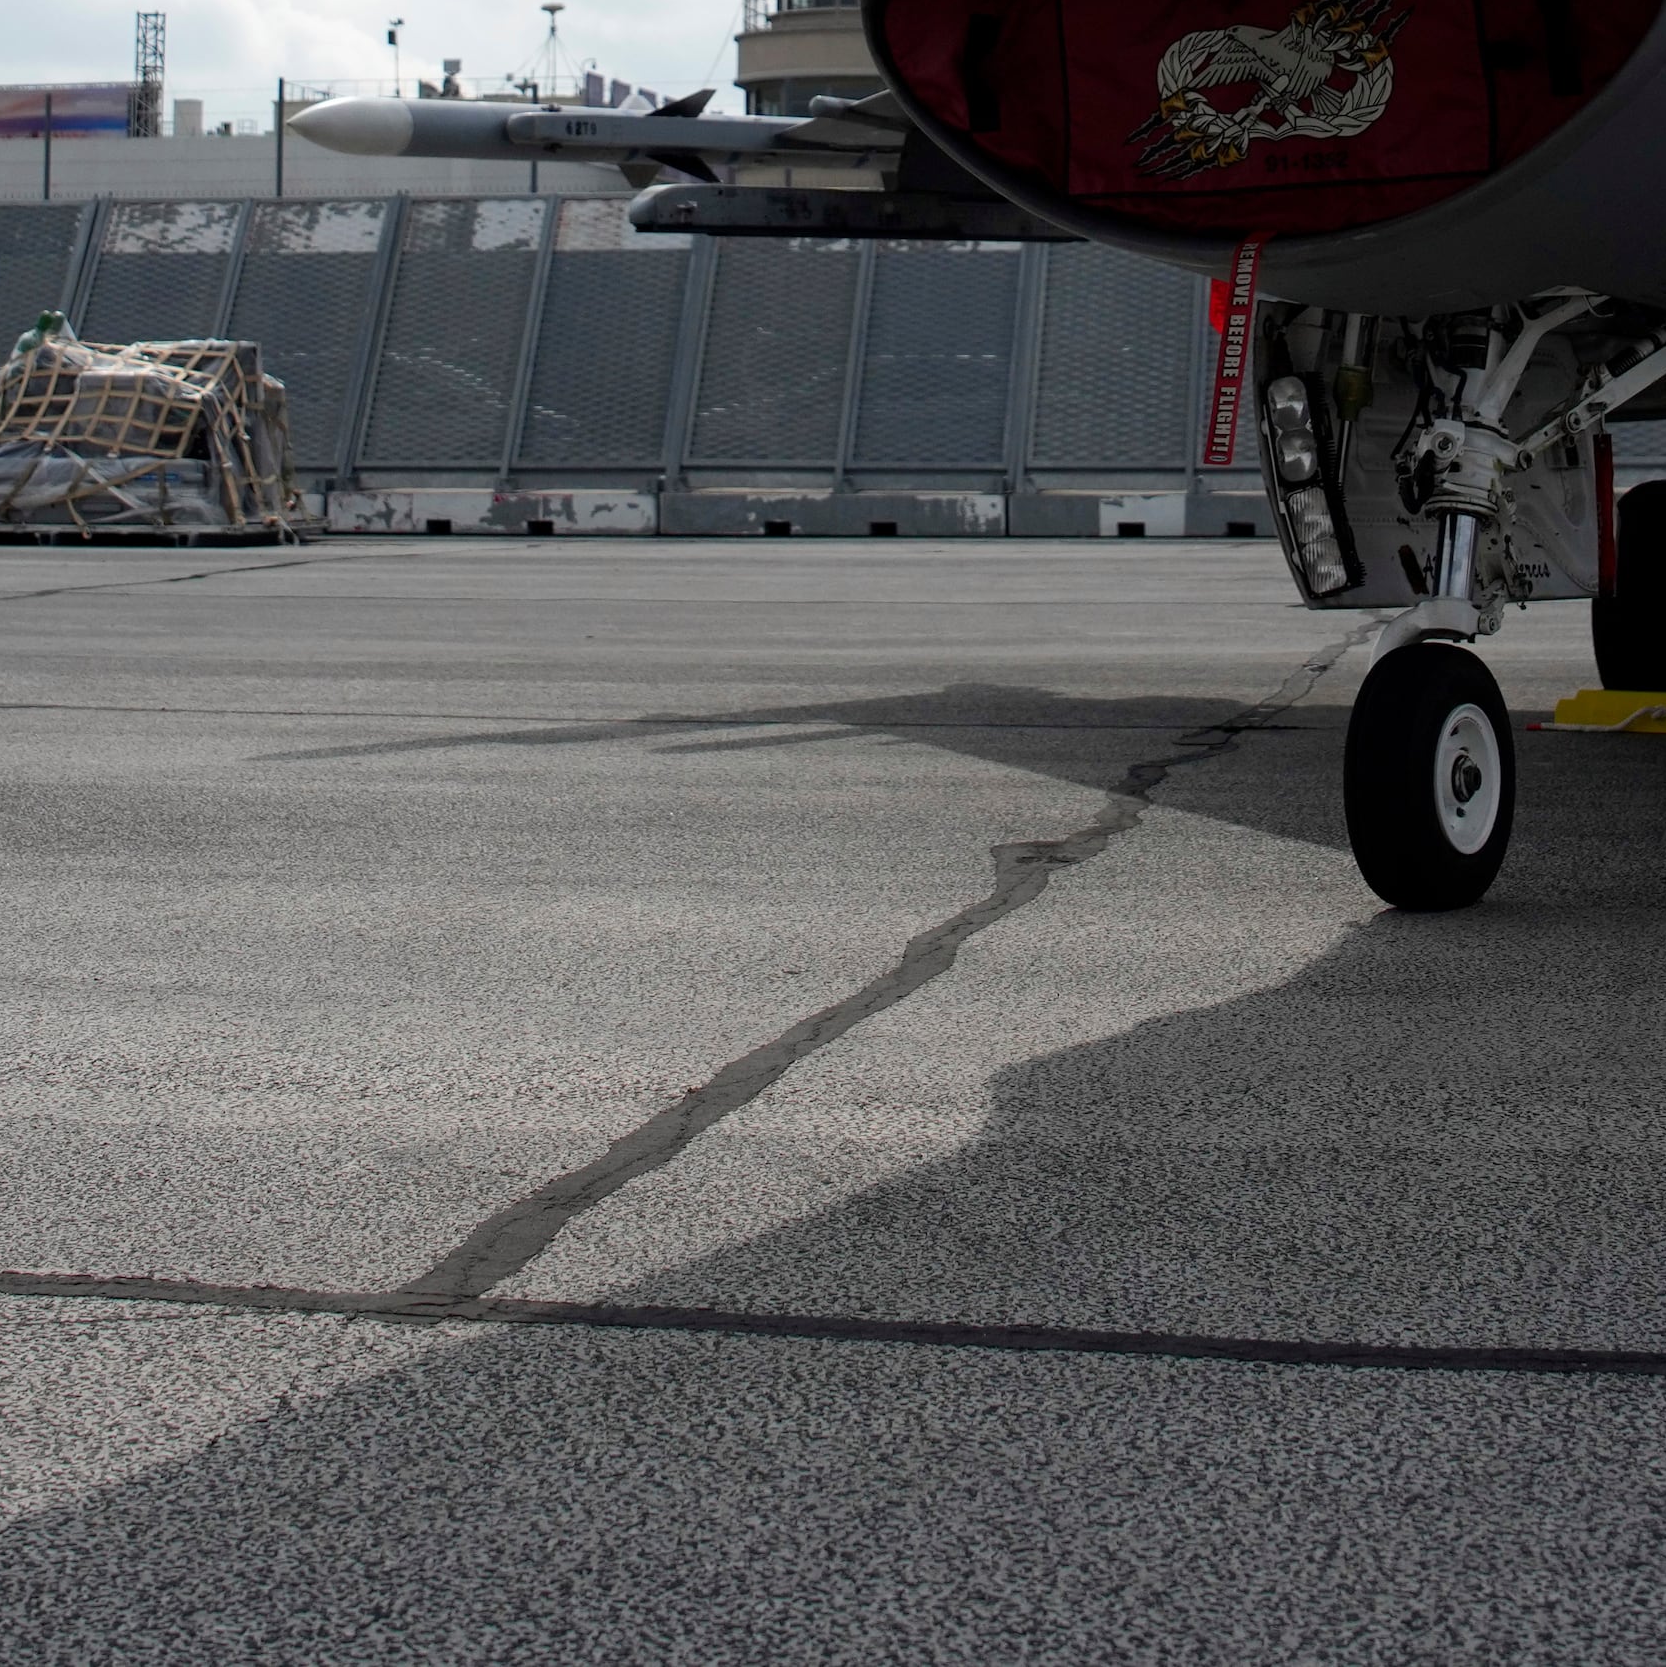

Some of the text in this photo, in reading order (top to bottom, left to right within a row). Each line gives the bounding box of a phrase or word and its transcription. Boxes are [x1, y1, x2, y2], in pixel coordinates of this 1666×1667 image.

[1212, 242, 1259, 452] REMOVE BEFORE FLIGHT!
